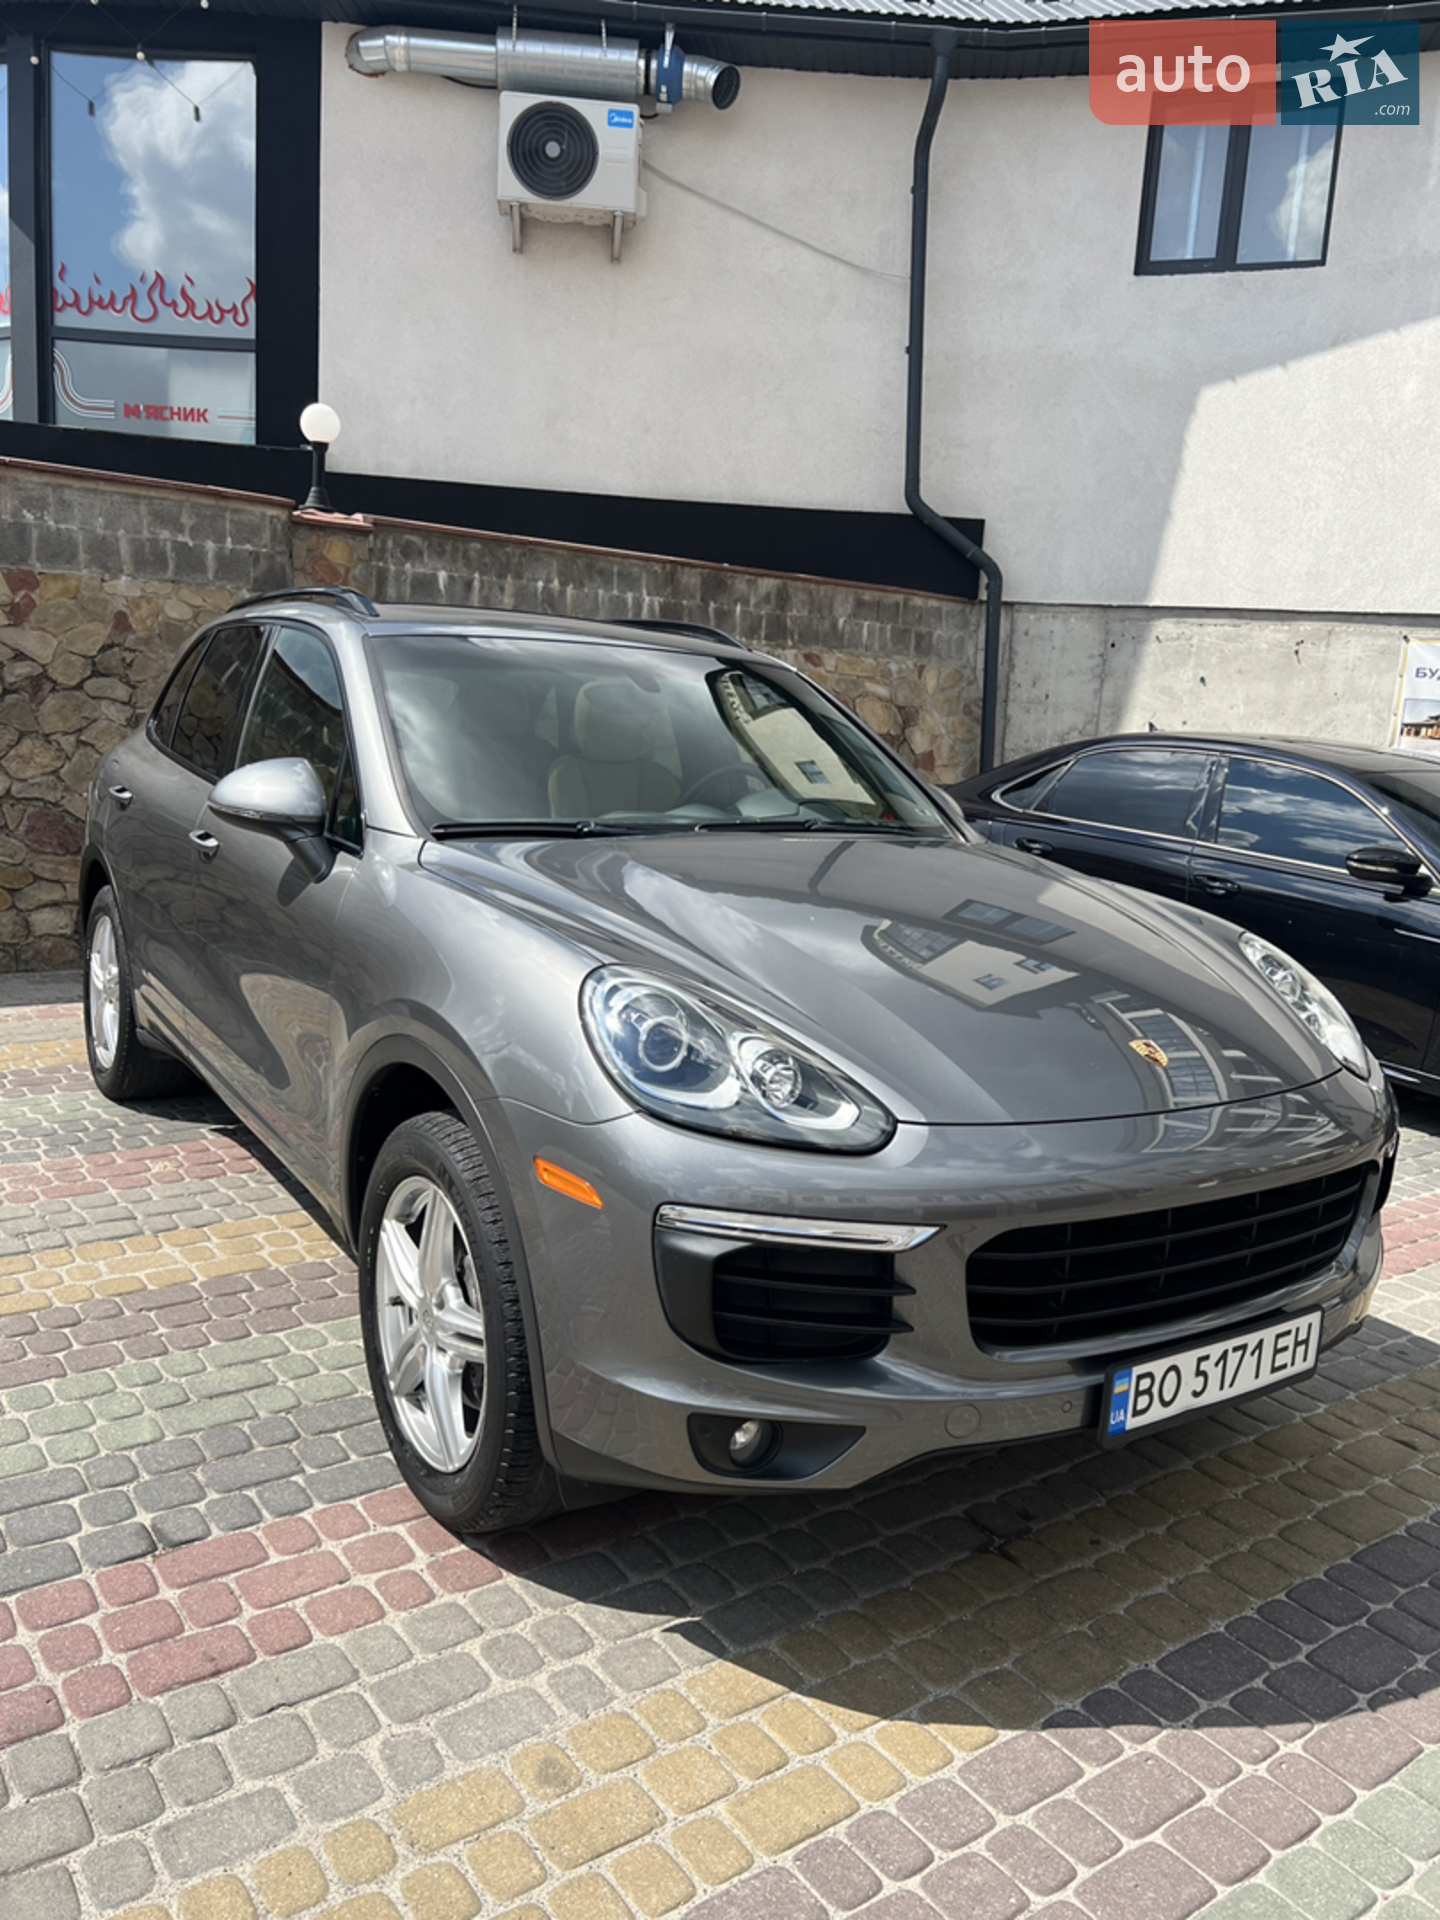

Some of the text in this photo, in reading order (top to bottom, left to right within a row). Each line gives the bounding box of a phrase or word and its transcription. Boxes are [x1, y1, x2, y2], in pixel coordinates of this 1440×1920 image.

[1110, 1323, 1312, 1425] UA BO 5171 EH
